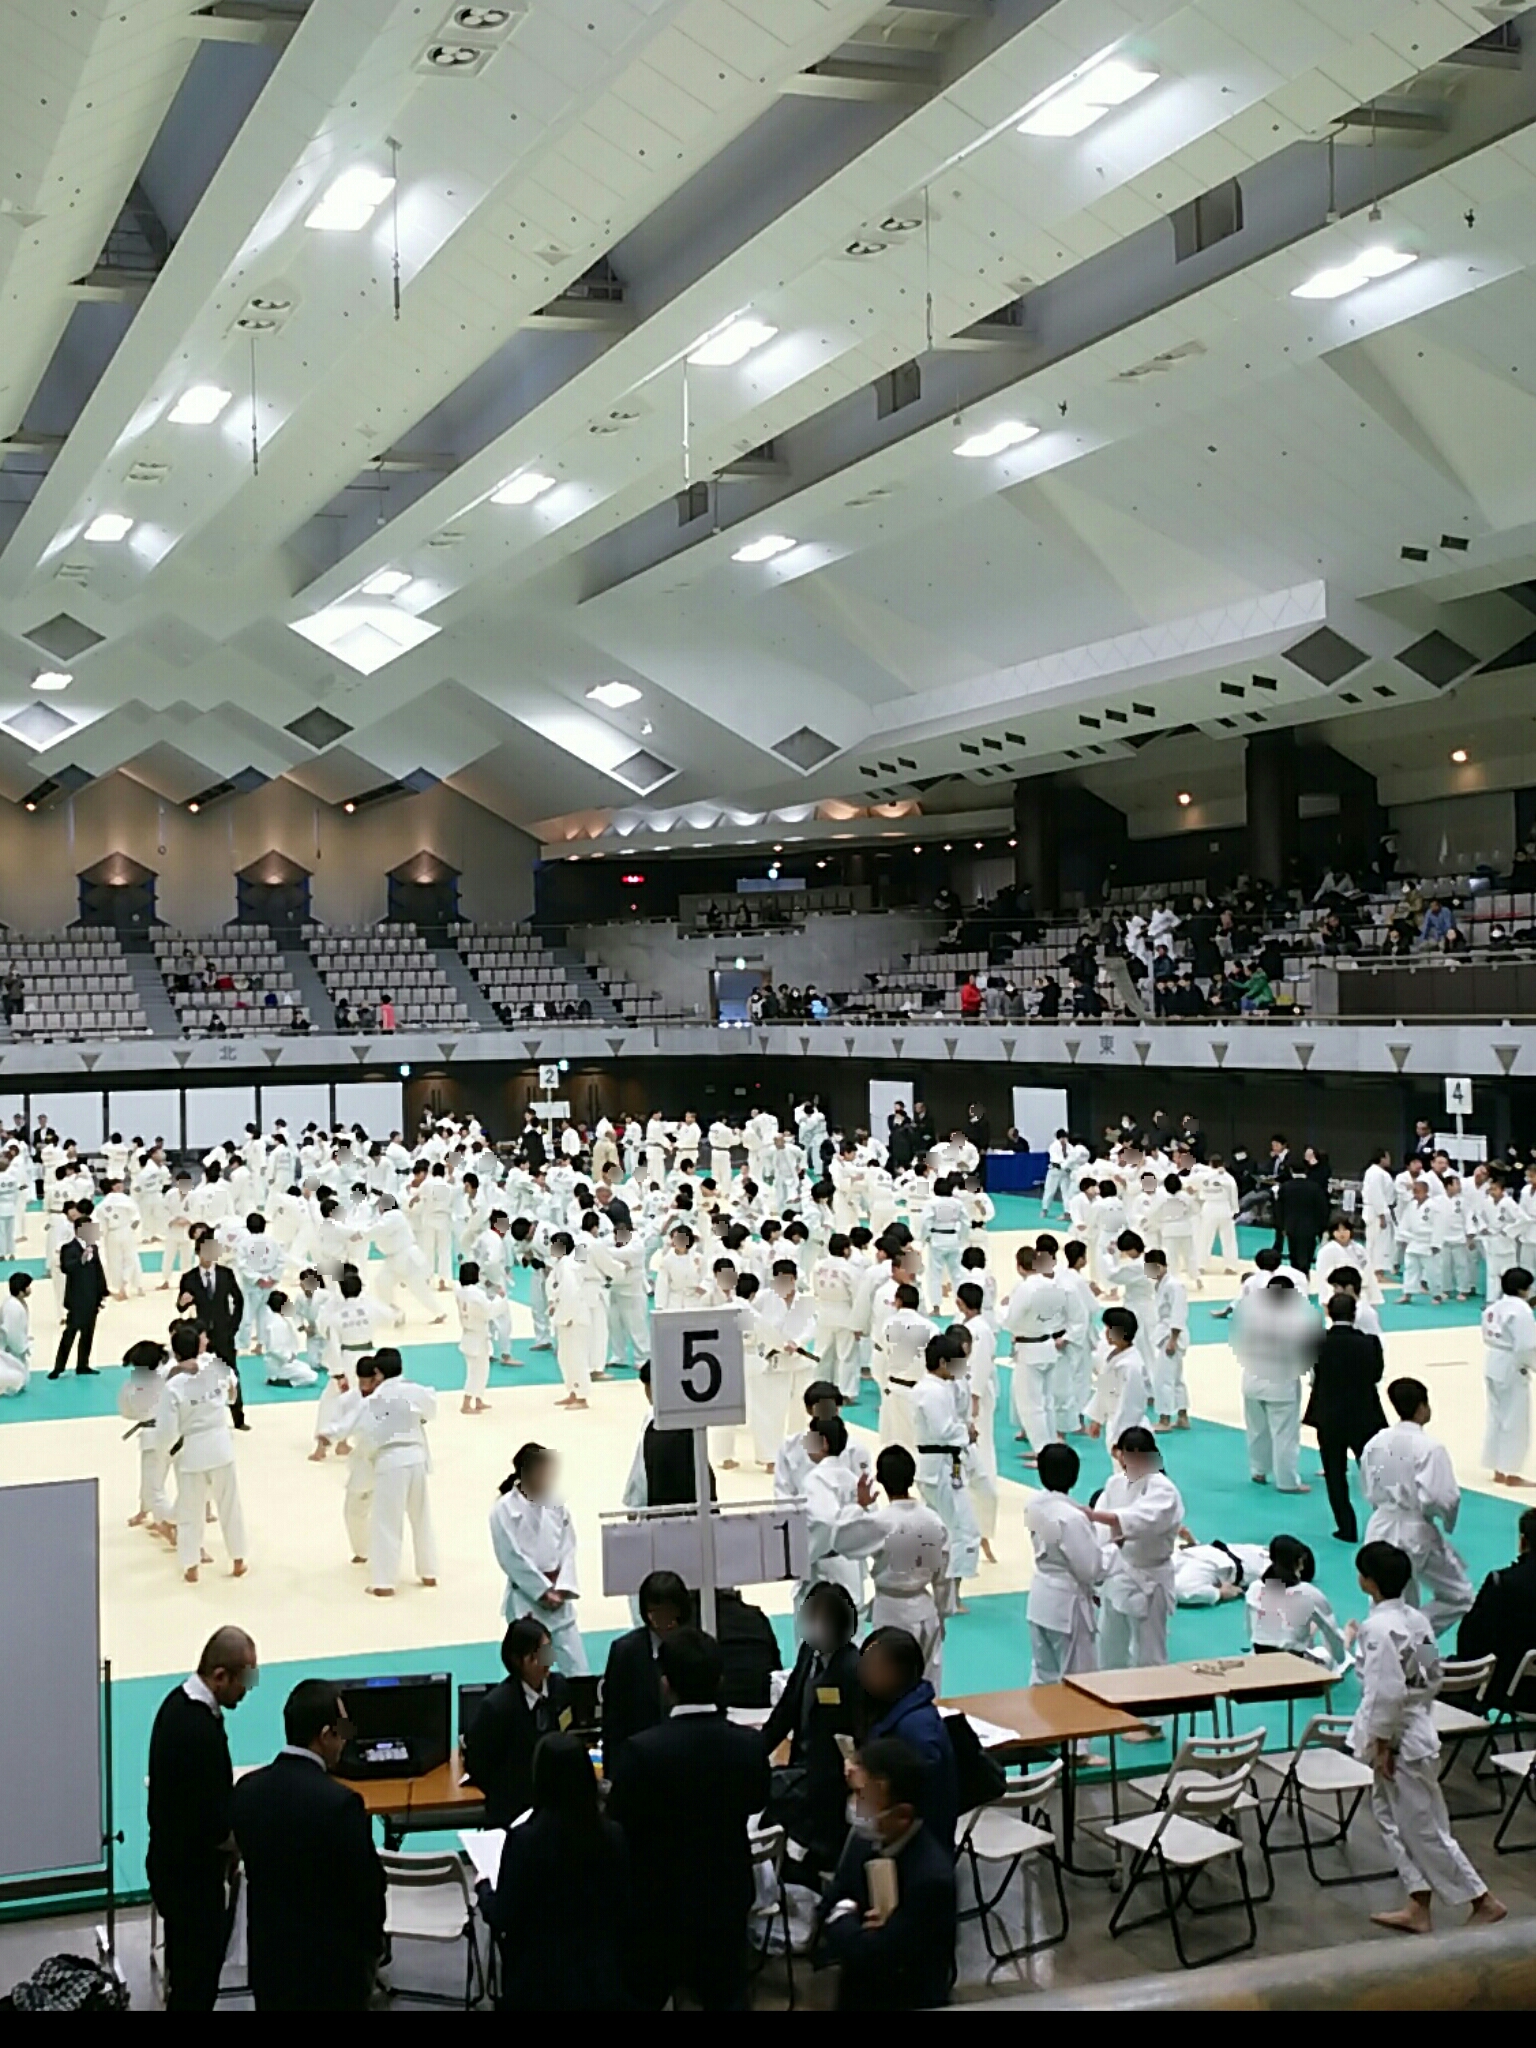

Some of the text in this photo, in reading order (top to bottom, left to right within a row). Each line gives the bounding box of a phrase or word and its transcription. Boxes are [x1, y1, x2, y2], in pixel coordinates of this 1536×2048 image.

[219, 1045, 237, 1061] 北
[1099, 1034, 1115, 1055] 東
[545, 1068, 555, 1084] 2
[1452, 1082, 1463, 1105] 4
[681, 1329, 722, 1403] 5
[773, 1519, 801, 1581] 1
